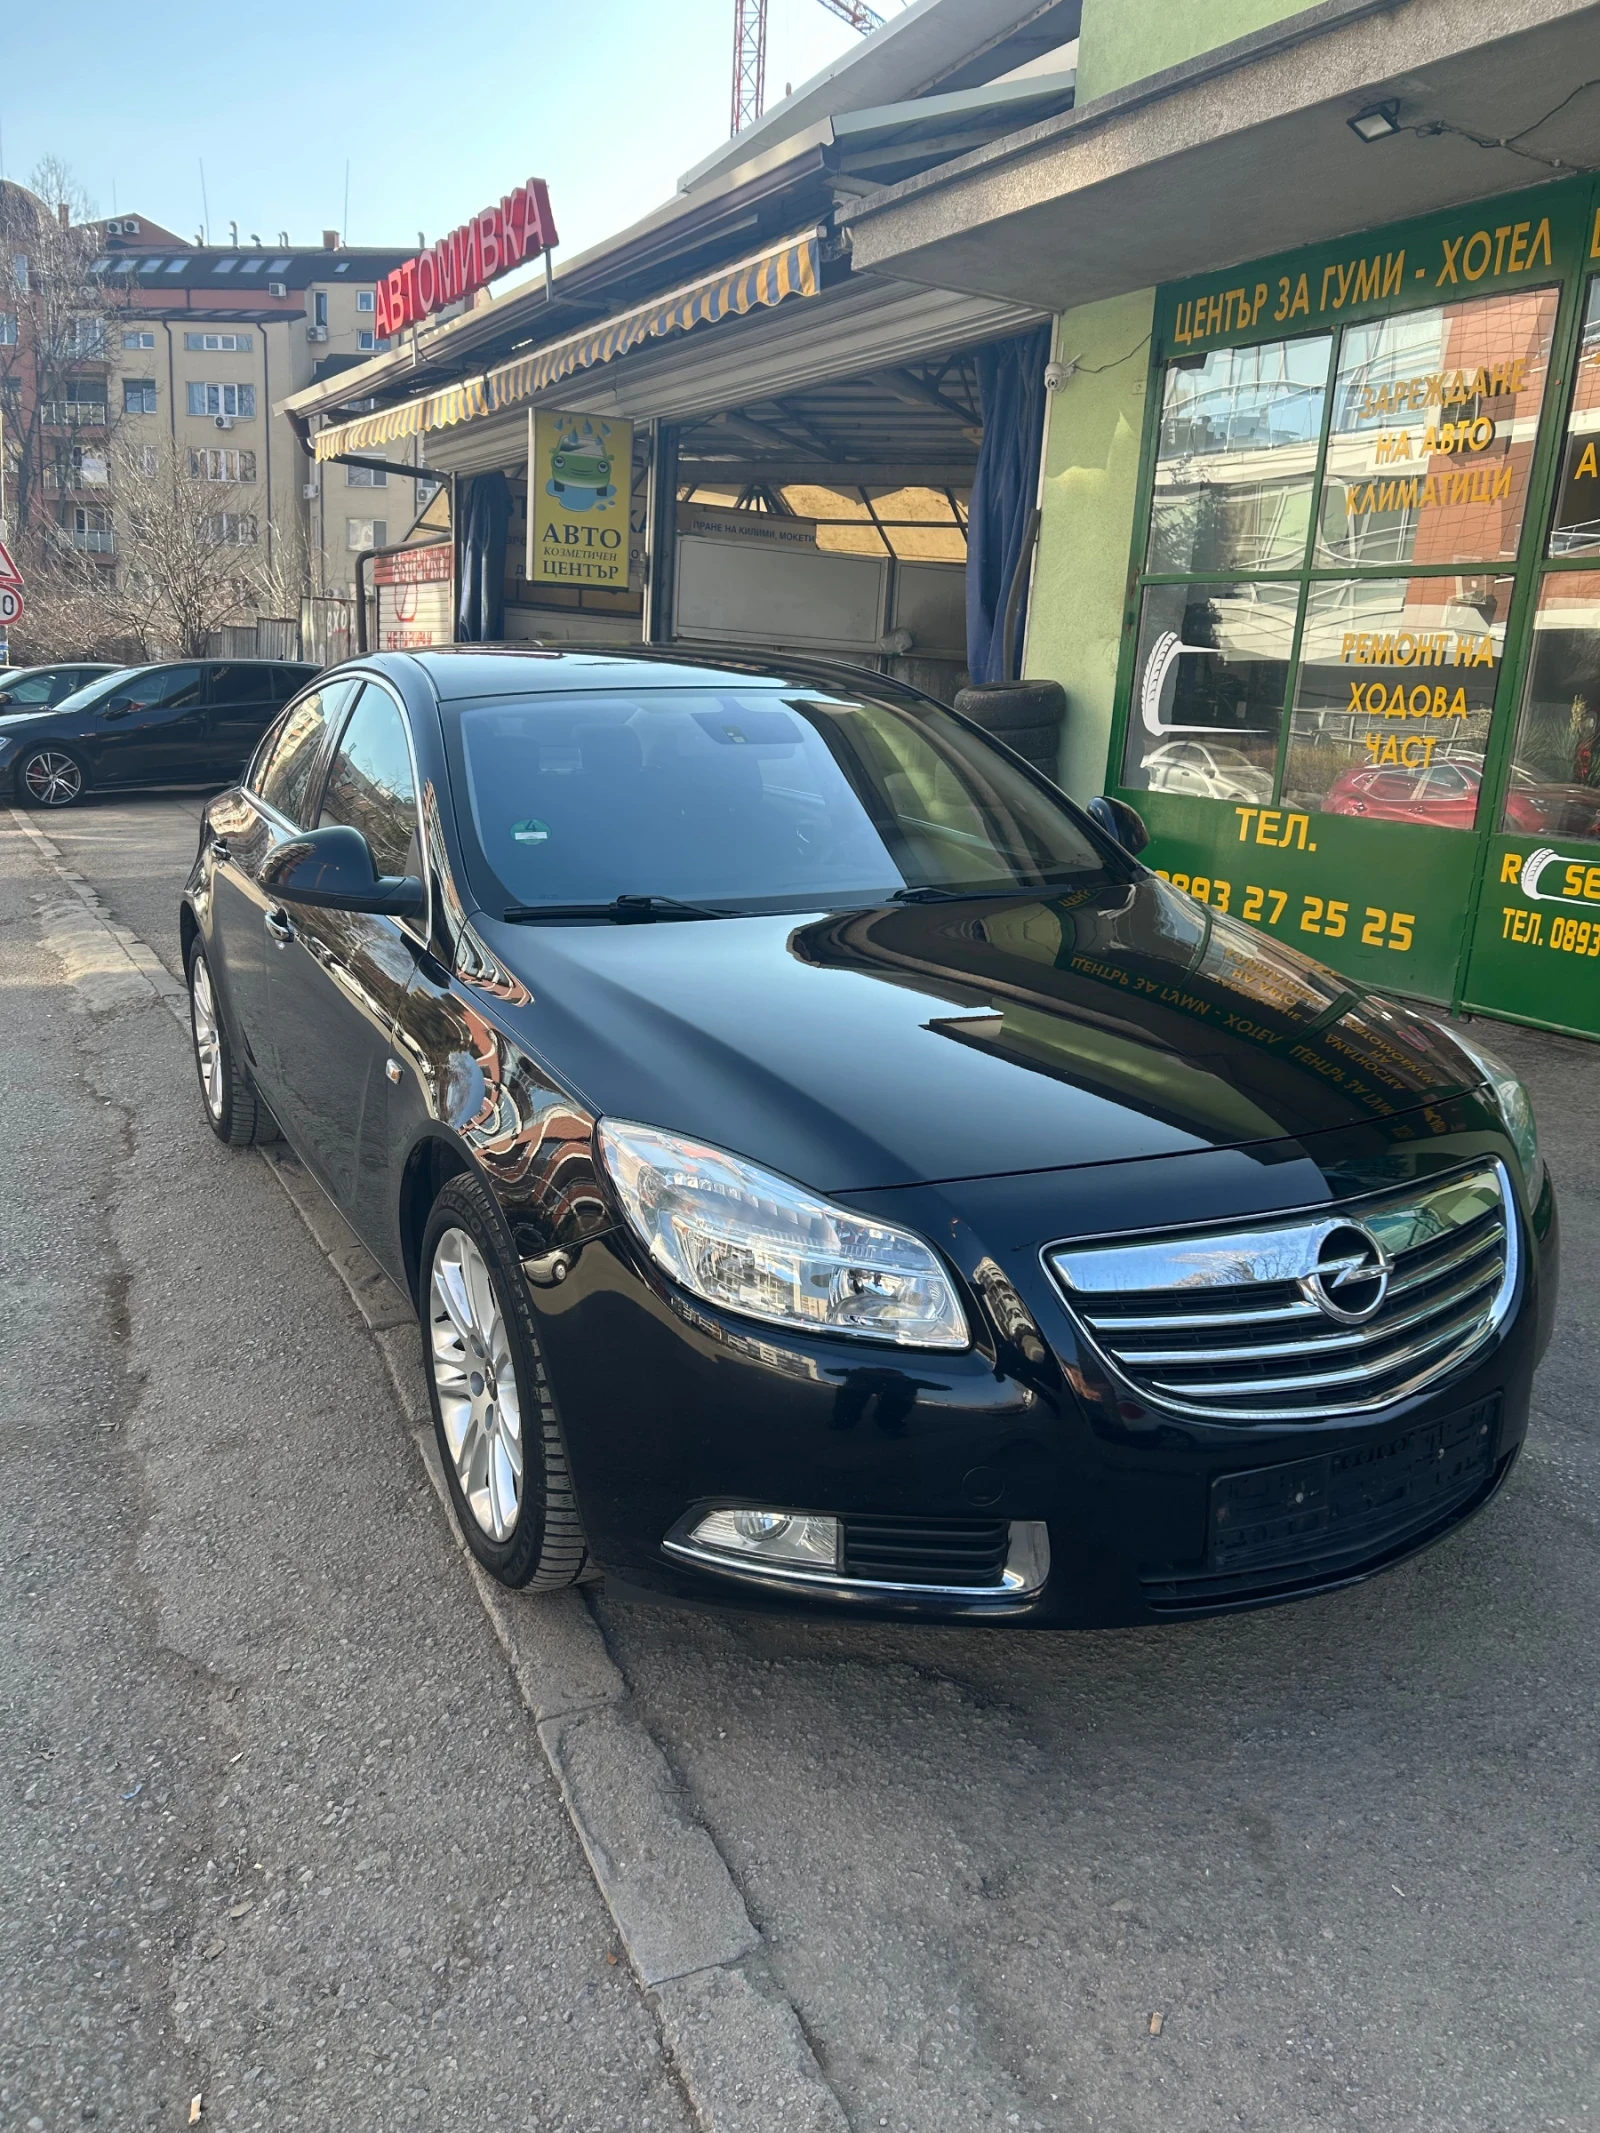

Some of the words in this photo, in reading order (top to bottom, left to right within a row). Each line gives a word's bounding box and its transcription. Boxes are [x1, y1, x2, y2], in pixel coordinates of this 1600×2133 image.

[376, 177, 556, 340] АВТОМИВКА
[1174, 283, 1268, 346] ЦЕНТЪР
[1274, 273, 1309, 321] ЗА
[1320, 249, 1405, 312] ГУМИ
[1415, 268, 1426, 279] -
[1435, 217, 1552, 287] ХОТЕЛ
[1358, 358, 1528, 419] ЗАРЕЖДАНЕ
[1375, 430, 1411, 465] НА
[1419, 416, 1494, 458] АВТО
[1345, 465, 1513, 515] КЛИМАТИЦИ
[542, 523, 622, 549] АВТО
[693, 520, 723, 533] ПРАНЕ
[725, 525, 737, 533] НА
[779, 532, 815, 542] МОКЕТИ
[542, 560, 619, 579] ЦЕНТЪР
[543, 547, 618, 562] КОЗМЕТИЧЕН
[1340, 633, 1448, 667] РЕМОНТ
[1453, 634, 1494, 668] НА
[1346, 682, 1467, 720] ХОДОВА
[1366, 732, 1437, 769] ЧАСТ
[1235, 807, 1317, 852] ТЕЛ.
[1242, 885, 1288, 925] 27
[1300, 895, 1349, 938] 25
[1361, 907, 1415, 951] 25
[1502, 907, 1543, 946] ТЕЛ.
